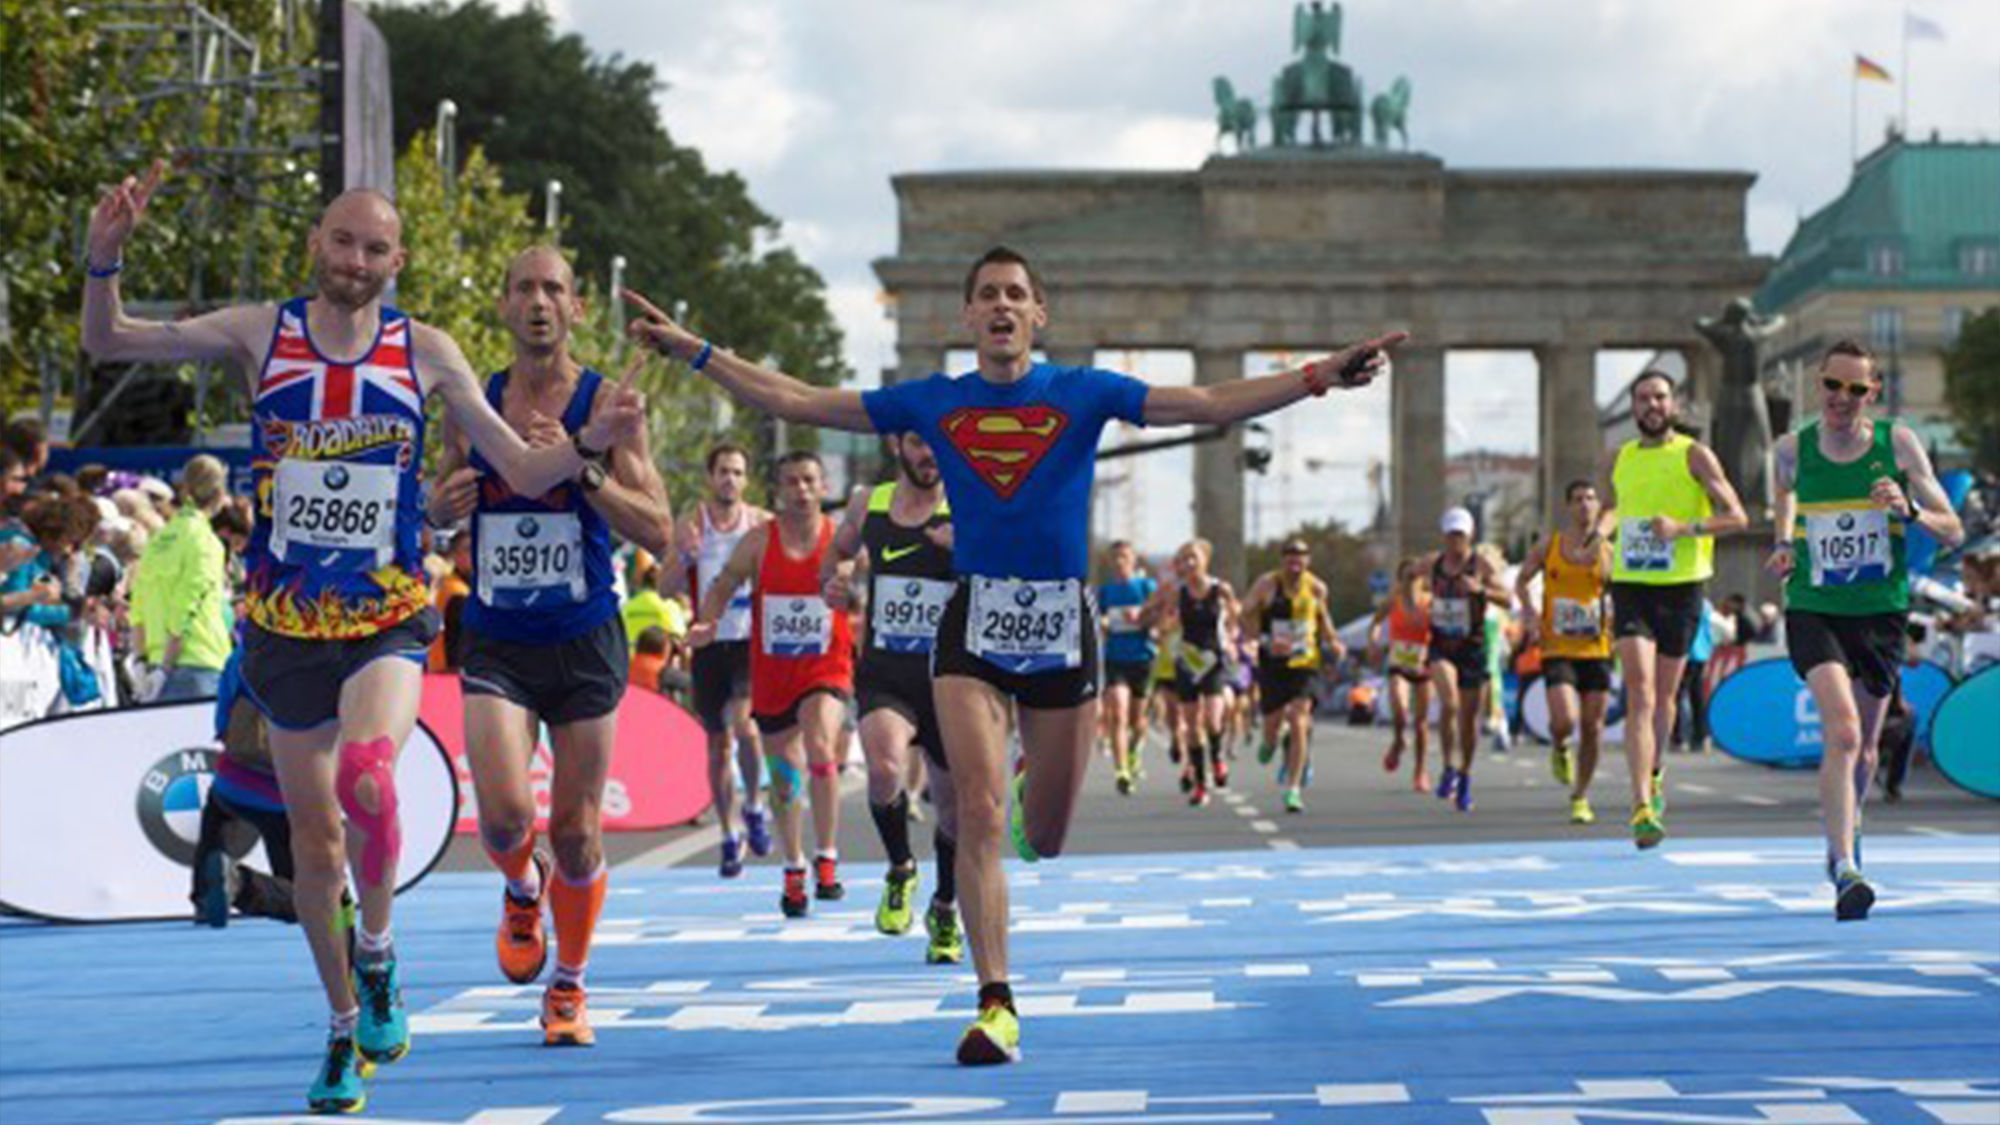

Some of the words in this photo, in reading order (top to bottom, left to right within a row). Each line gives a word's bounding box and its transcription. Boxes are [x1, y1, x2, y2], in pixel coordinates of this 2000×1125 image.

[289, 495, 379, 534] 25868
[493, 544, 569, 575] 35910
[1820, 532, 1878, 560] 10517
[983, 610, 1064, 641] 29843
